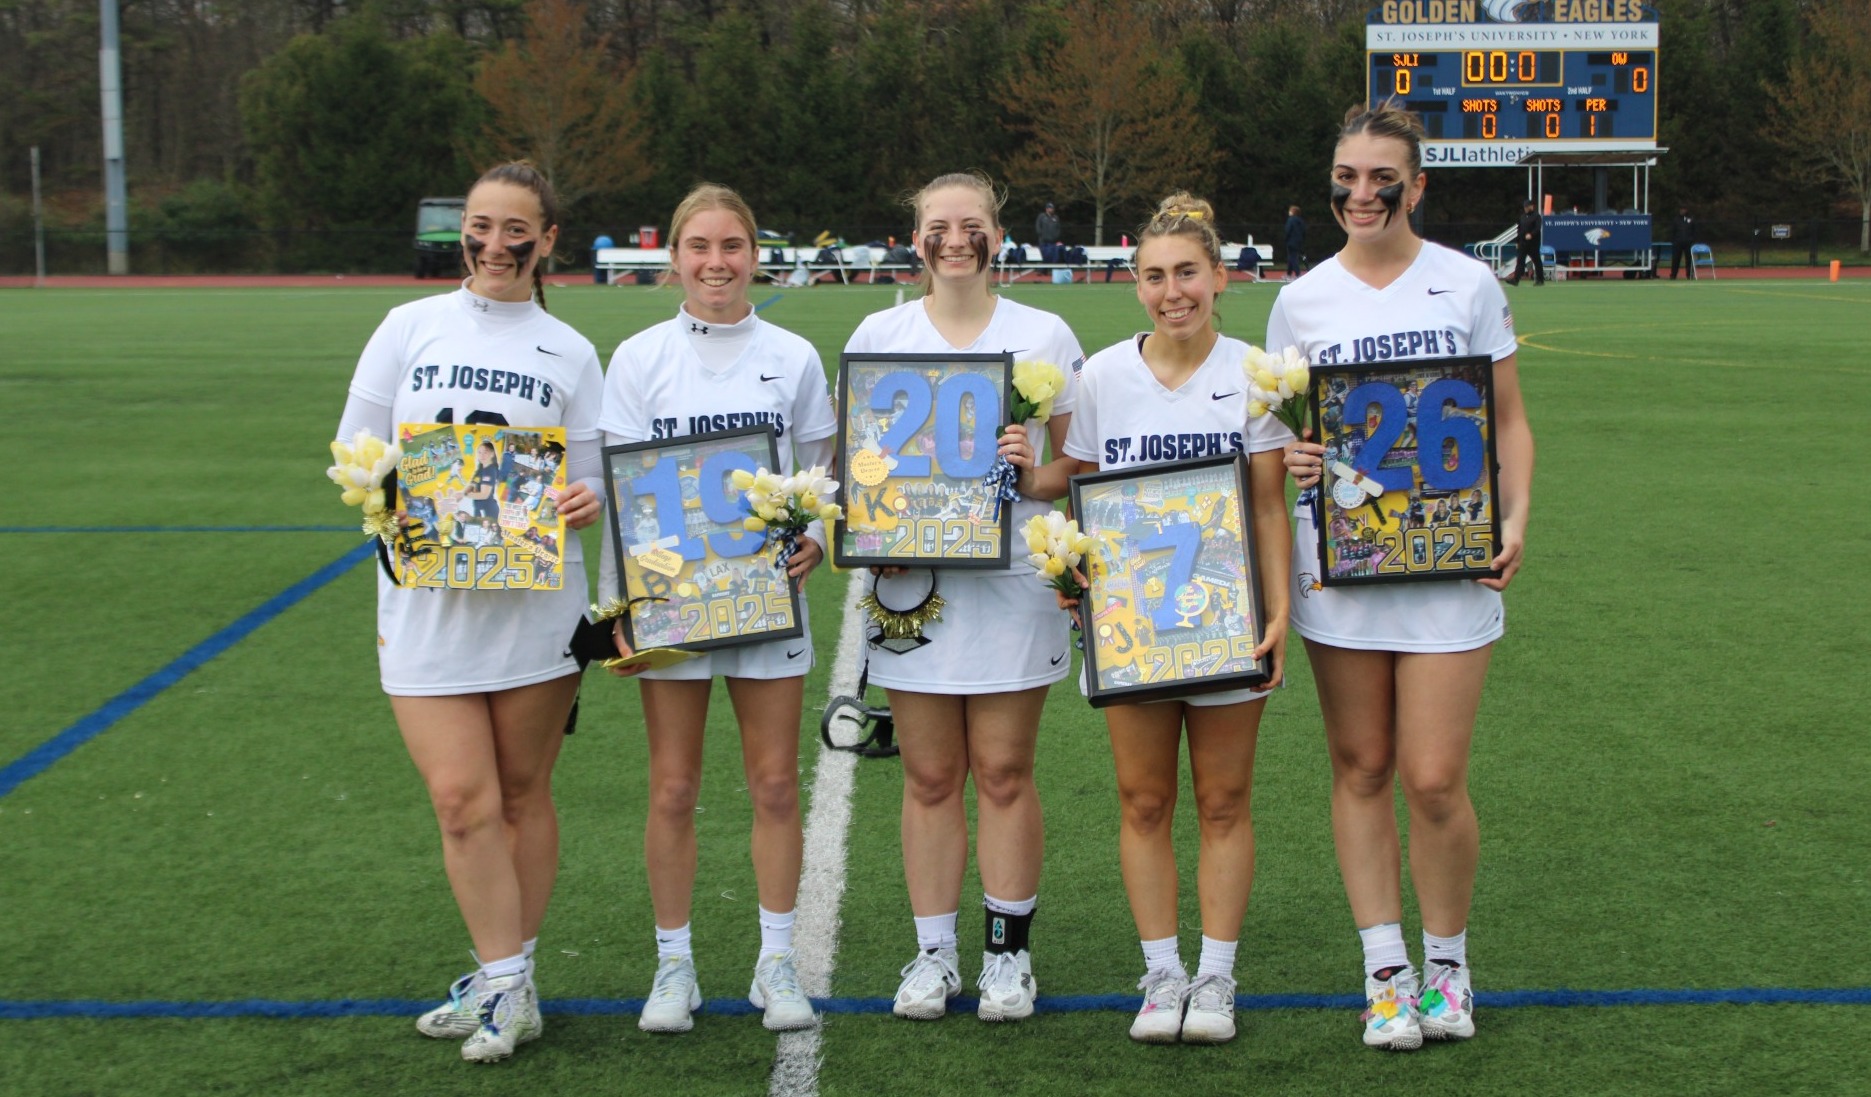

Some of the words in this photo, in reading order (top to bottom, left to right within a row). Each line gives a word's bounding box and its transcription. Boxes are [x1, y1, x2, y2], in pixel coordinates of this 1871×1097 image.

[1382, 0, 1476, 23] GOLDEN
[1554, 0, 1643, 22] EAGLES
[1376, 31, 1397, 42] ST.
[1401, 31, 1466, 43] JOSEPH'S
[1470, 30, 1558, 42] UNIVERSITY
[1573, 30, 1605, 41] NEW
[1610, 29, 1649, 41] YORK
[1392, 53, 1419, 67] SJLI
[1395, 69, 1411, 94] 0
[1441, 87, 1456, 96] HALF
[1578, 86, 1592, 95] HALF
[1632, 67, 1649, 93] 0
[1461, 99, 1498, 113] SHOTS
[1526, 99, 1561, 113] SHOTS
[1585, 99, 1607, 112] PER
[1481, 113, 1497, 139] 0
[1545, 113, 1560, 139] 0
[1425, 147, 1534, 163] SJLIathleti
[1352, 329, 1457, 363] JOSEPH'S
[411, 364, 444, 393] ST.
[447, 365, 554, 409] JOSEPH'S
[870, 370, 1000, 479] 20
[1342, 378, 1485, 493] 26
[1104, 437, 1136, 465] ST.
[1138, 431, 1245, 462] JOSEPH'S
[863, 486, 896, 523] K
[887, 518, 1000, 558] 2025
[1375, 525, 1494, 575] 2025
[415, 544, 536, 591] 2025
[709, 562, 731, 578] LAX
[680, 591, 795, 645] 2025
[1115, 621, 1134, 654] J
[1145, 634, 1257, 684] 2025
